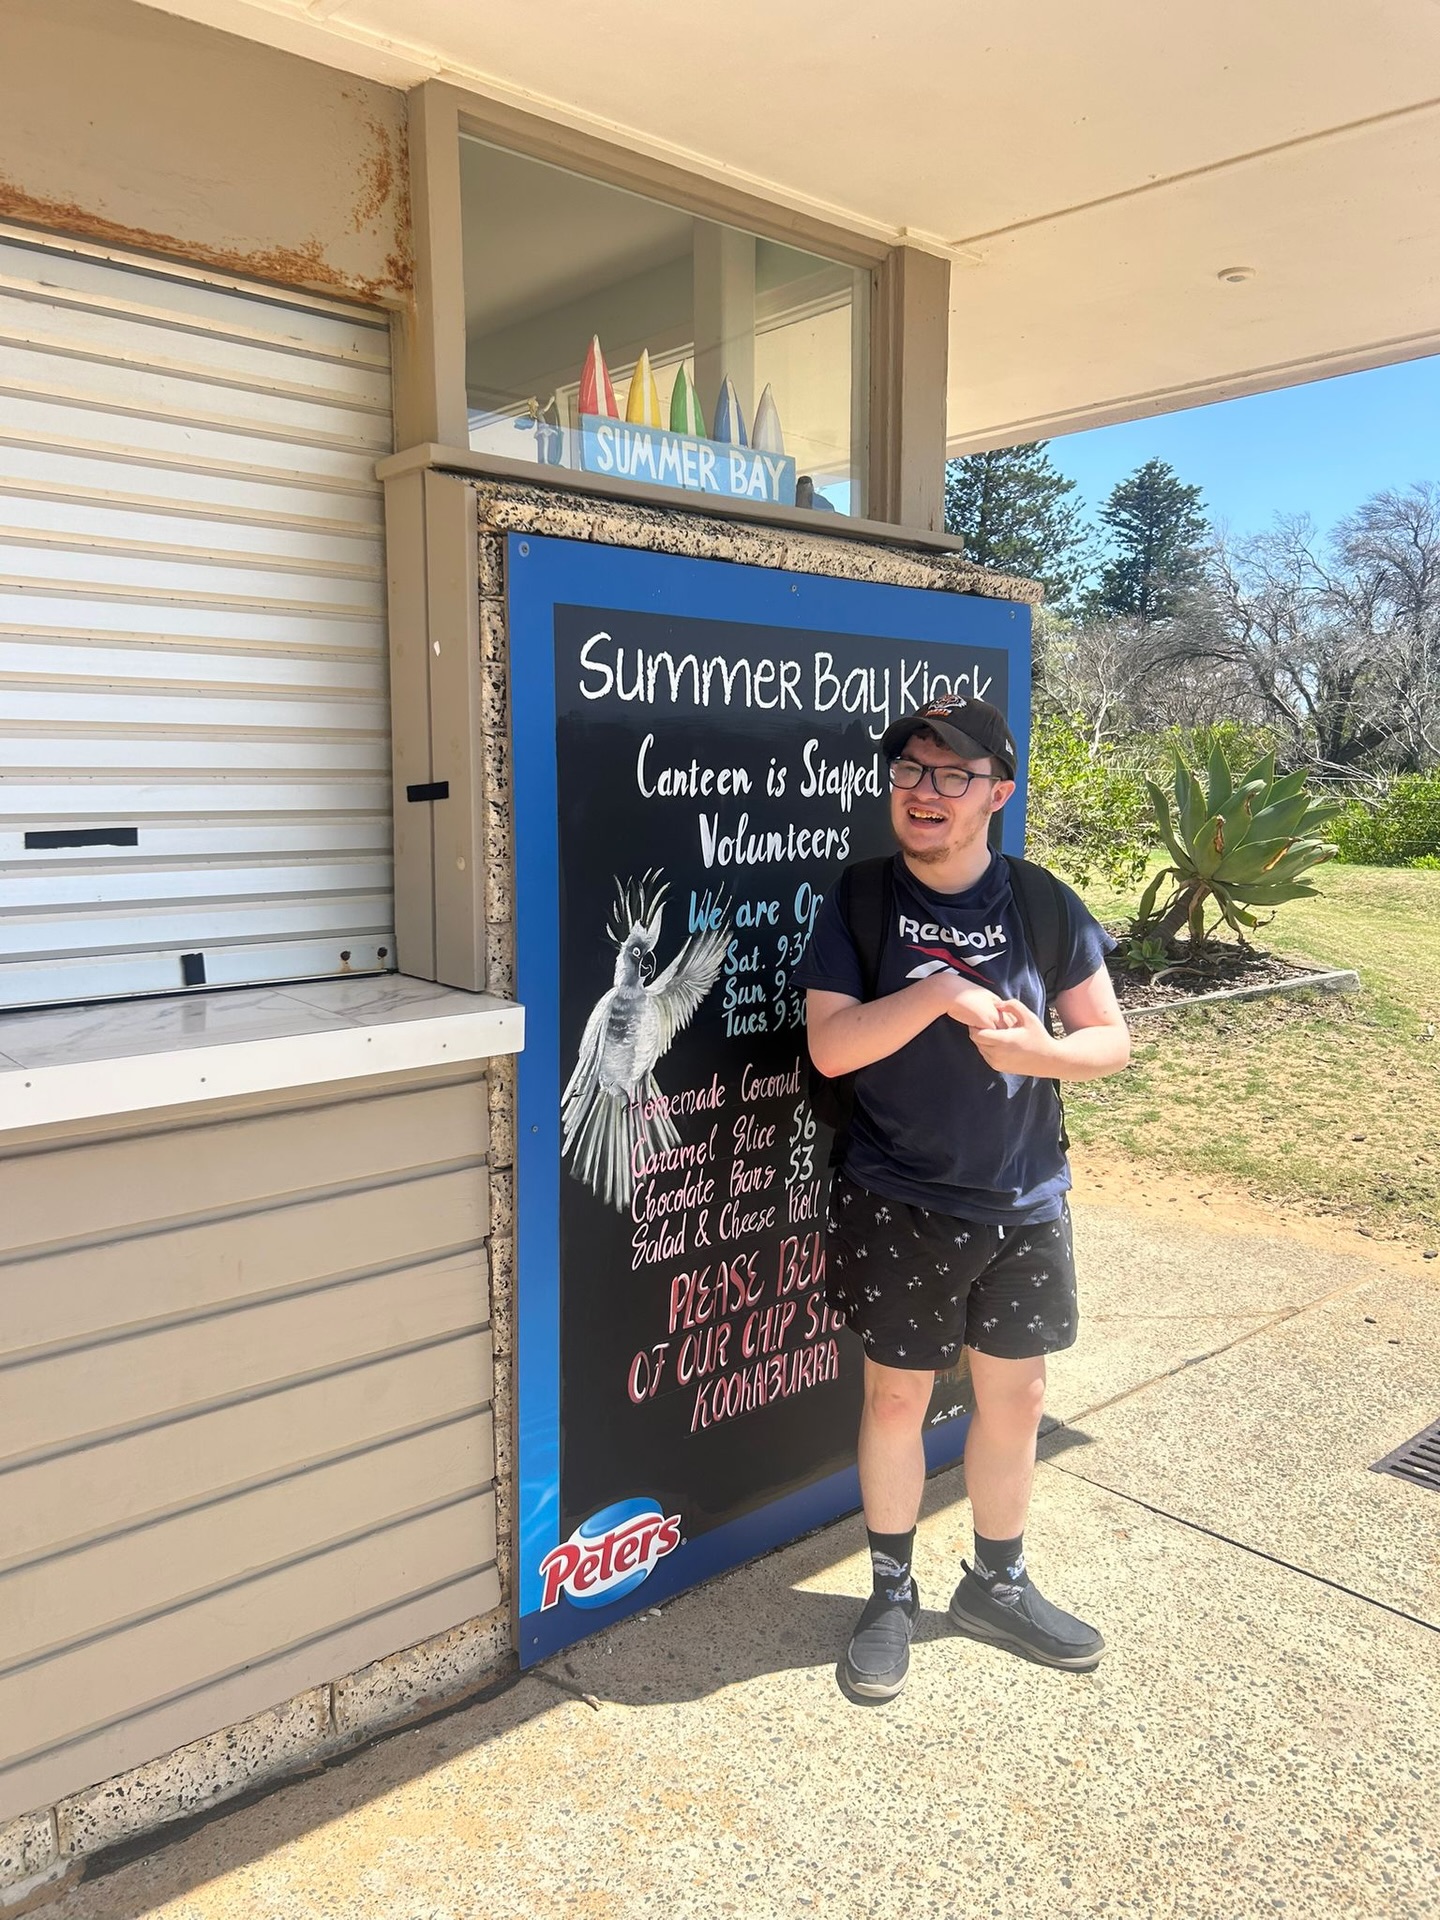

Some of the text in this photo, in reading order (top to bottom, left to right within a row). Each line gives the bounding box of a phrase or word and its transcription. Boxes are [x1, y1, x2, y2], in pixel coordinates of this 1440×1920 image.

[595, 424, 786, 501] SUMMER BAY
[813, 652, 890, 740] Bay
[636, 733, 753, 798] Canteen
[767, 757, 788, 797] is
[800, 739, 883, 813] Staffed
[699, 813, 851, 869] Volunteers
[688, 888, 723, 934] We
[736, 899, 780, 928] are
[722, 976, 767, 1010] Sun.
[723, 938, 766, 976] Sat.
[722, 1004, 768, 1037] Tues.
[629, 1056, 801, 1140] Homemade Coconut
[631, 1100, 817, 1179] Caramel Slice $6
[631, 1143, 814, 1224] Chocolate Bars $3
[631, 1212, 687, 1271] Salad
[694, 1209, 711, 1248] &
[719, 1199, 776, 1240] Cheese
[789, 1179, 821, 1223] Roll
[668, 1250, 765, 1334] PLEASE
[628, 1342, 670, 1404] OF
[677, 1322, 732, 1385] OUR
[742, 1301, 797, 1358] CHIP
[690, 1338, 840, 1433] KOOKABURRA
[540, 1514, 681, 1612] Peters
